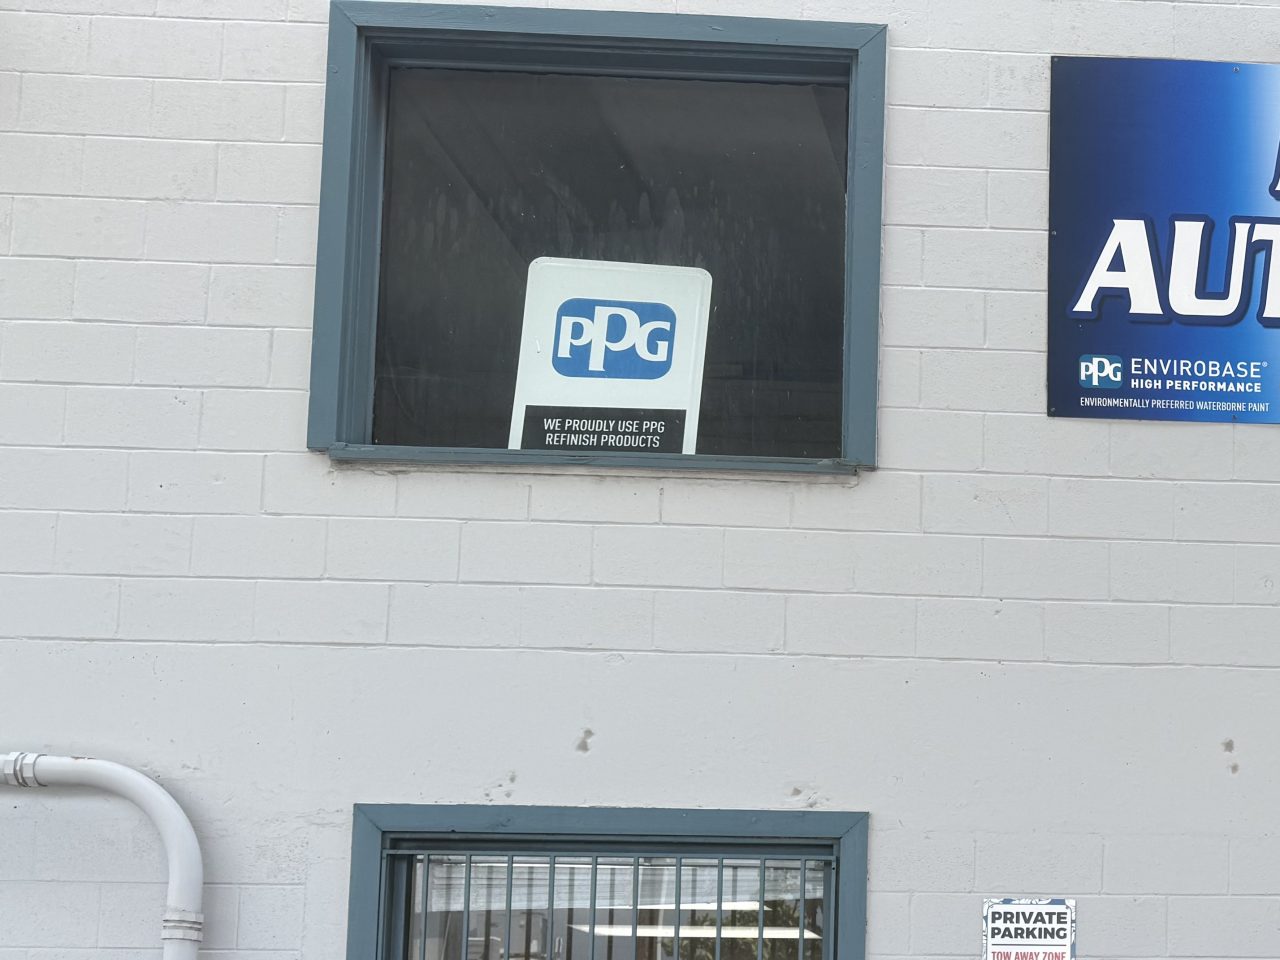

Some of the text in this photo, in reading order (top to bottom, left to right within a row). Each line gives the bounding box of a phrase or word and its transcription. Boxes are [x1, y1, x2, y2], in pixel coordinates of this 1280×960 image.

[557, 305, 671, 372] PPG
[1080, 357, 1122, 386] PPG
[1131, 378, 1262, 393] HIGH PERFORMANCE
[1080, 396, 1270, 413] ENVIRONMENTALLY PREFERRED WATERBORNE PAINT
[543, 417, 666, 434] WE PROUDLY USE PPG
[545, 432, 660, 448] REFINISH PRODUCTS
[991, 911, 1068, 925] PRIVATE
[990, 926, 1068, 940] PARKING
